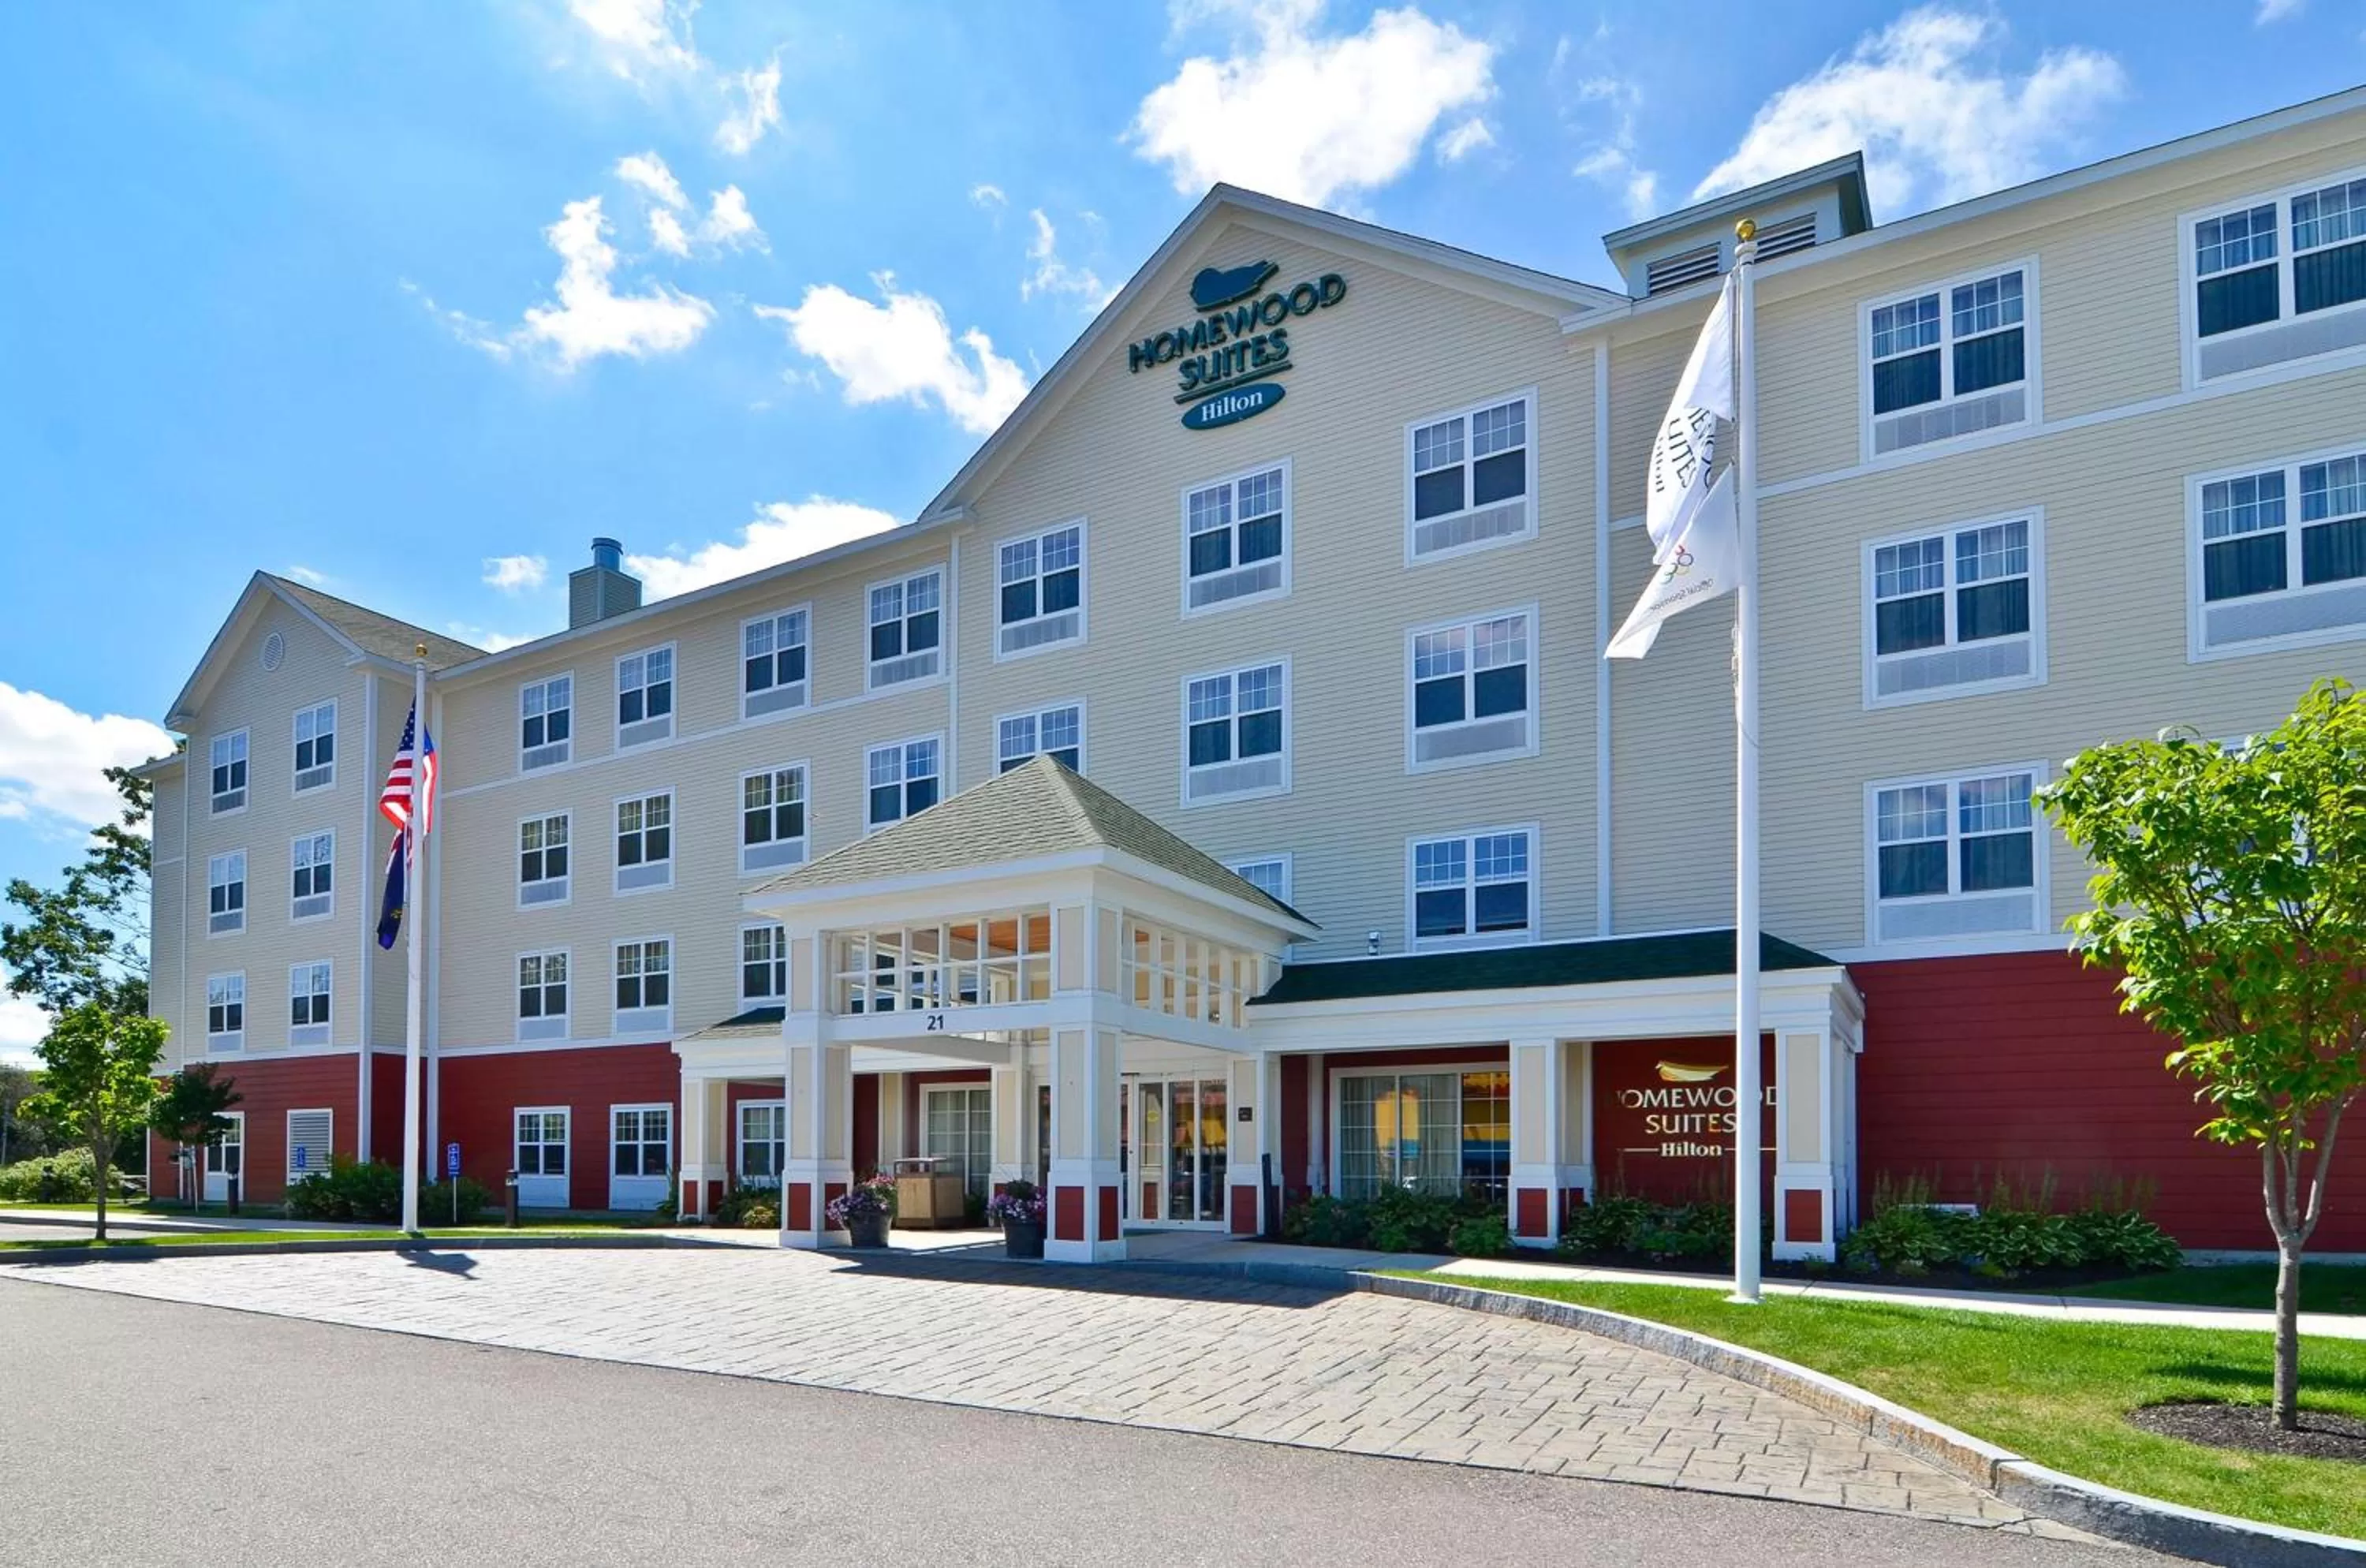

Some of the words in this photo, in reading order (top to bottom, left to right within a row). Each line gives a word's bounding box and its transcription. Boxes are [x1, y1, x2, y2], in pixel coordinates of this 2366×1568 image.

[1129, 274, 1347, 373] HOMEWOOD
[1178, 327, 1290, 390] SUITES
[1200, 390, 1263, 422] Hilton
[927, 1014, 944, 1031] 21
[1645, 1113, 1736, 1133] SUITES
[1661, 1142, 1722, 1157] Hilton
